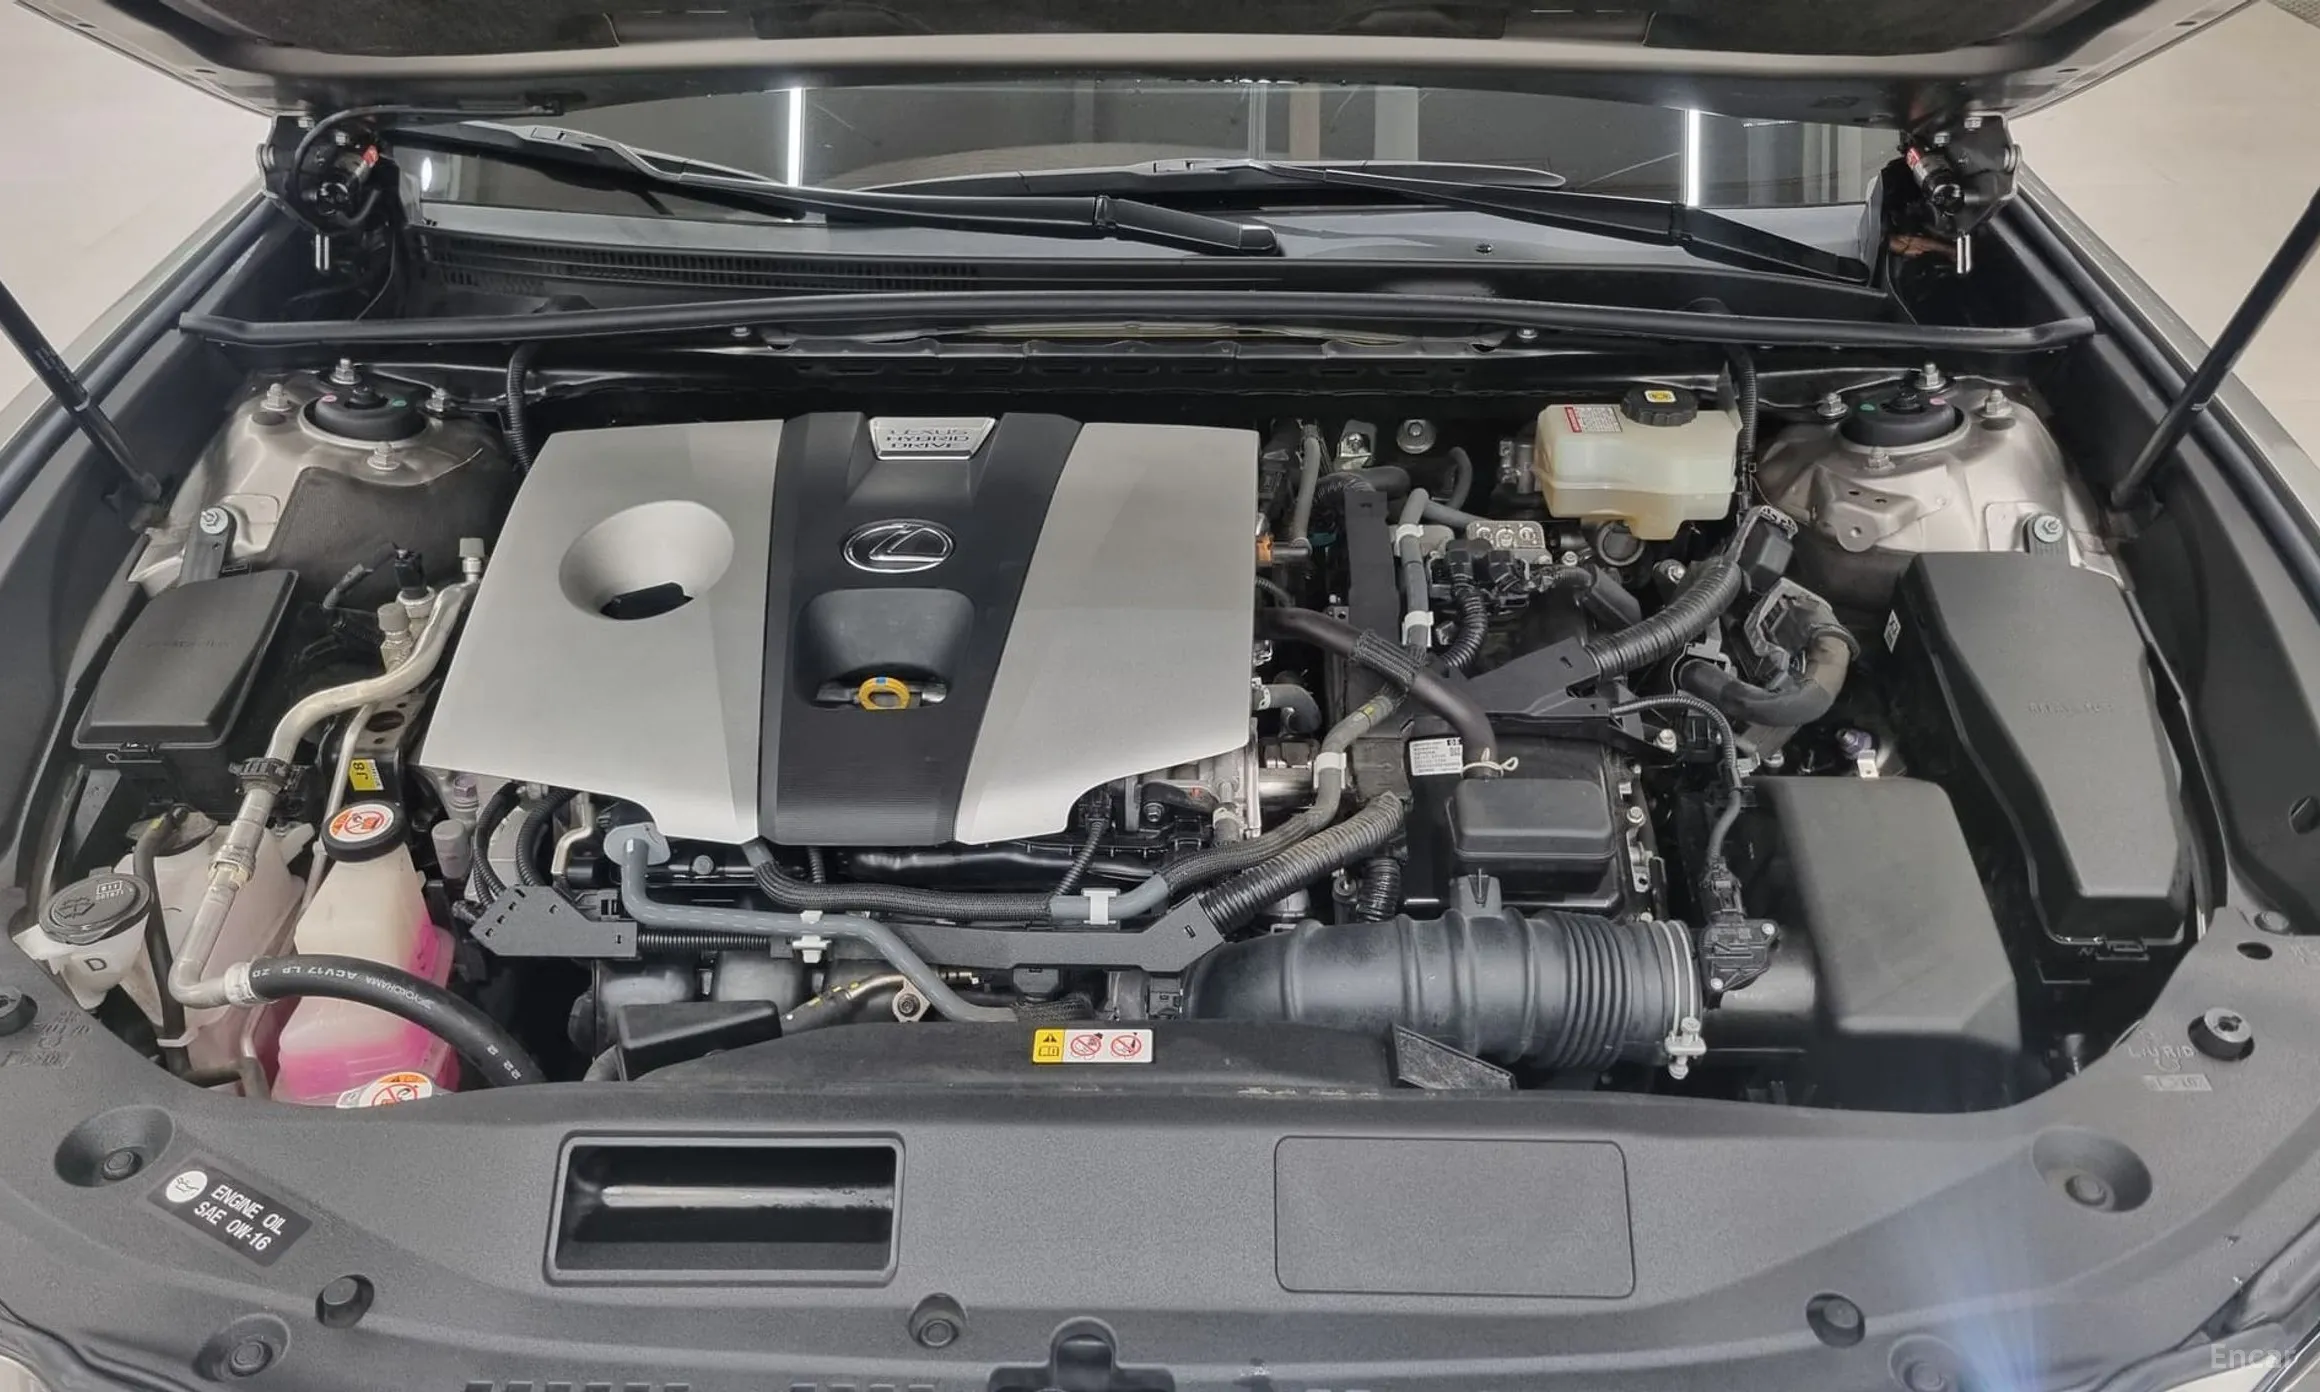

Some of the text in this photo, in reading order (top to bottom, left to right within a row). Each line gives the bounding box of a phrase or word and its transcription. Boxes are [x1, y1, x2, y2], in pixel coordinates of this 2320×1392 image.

[308, 966, 358, 980] ACV17
[193, 1201, 272, 1251] SAE 0W-16
[211, 1184, 287, 1236] ENGINE OIL
